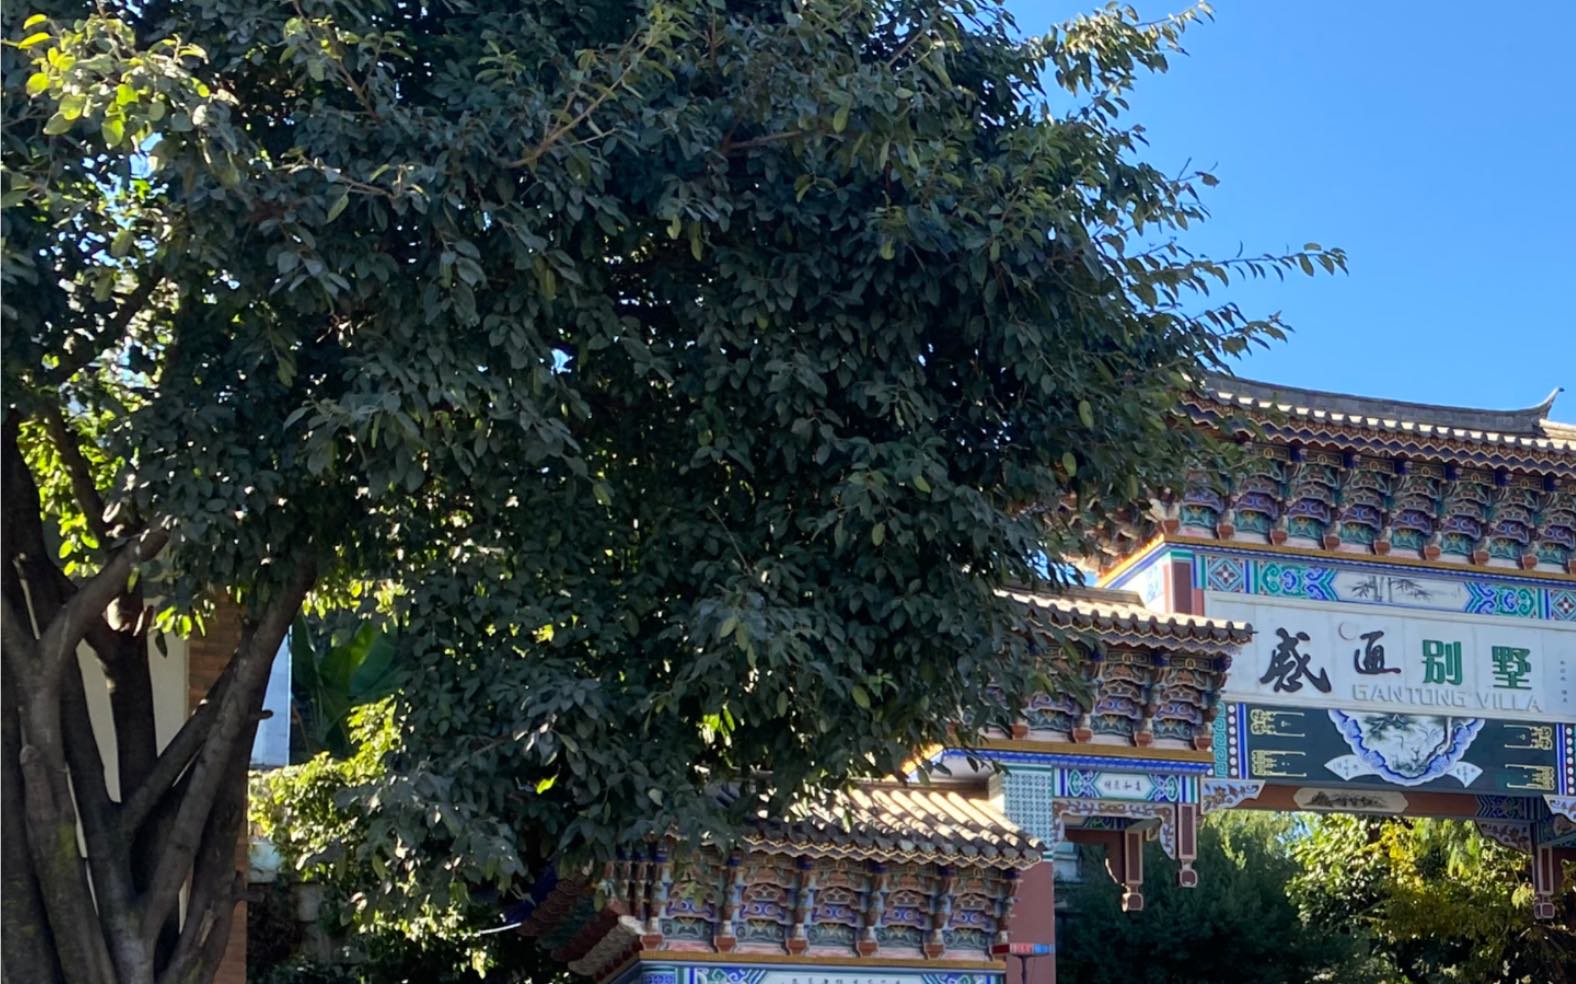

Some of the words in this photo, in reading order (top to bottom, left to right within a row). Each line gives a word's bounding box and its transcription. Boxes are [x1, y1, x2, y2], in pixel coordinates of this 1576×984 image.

[1259, 627, 1532, 694] 感通别墅
[1352, 684, 1467, 708] GANTONG
[1475, 690, 1543, 713] VILLA
